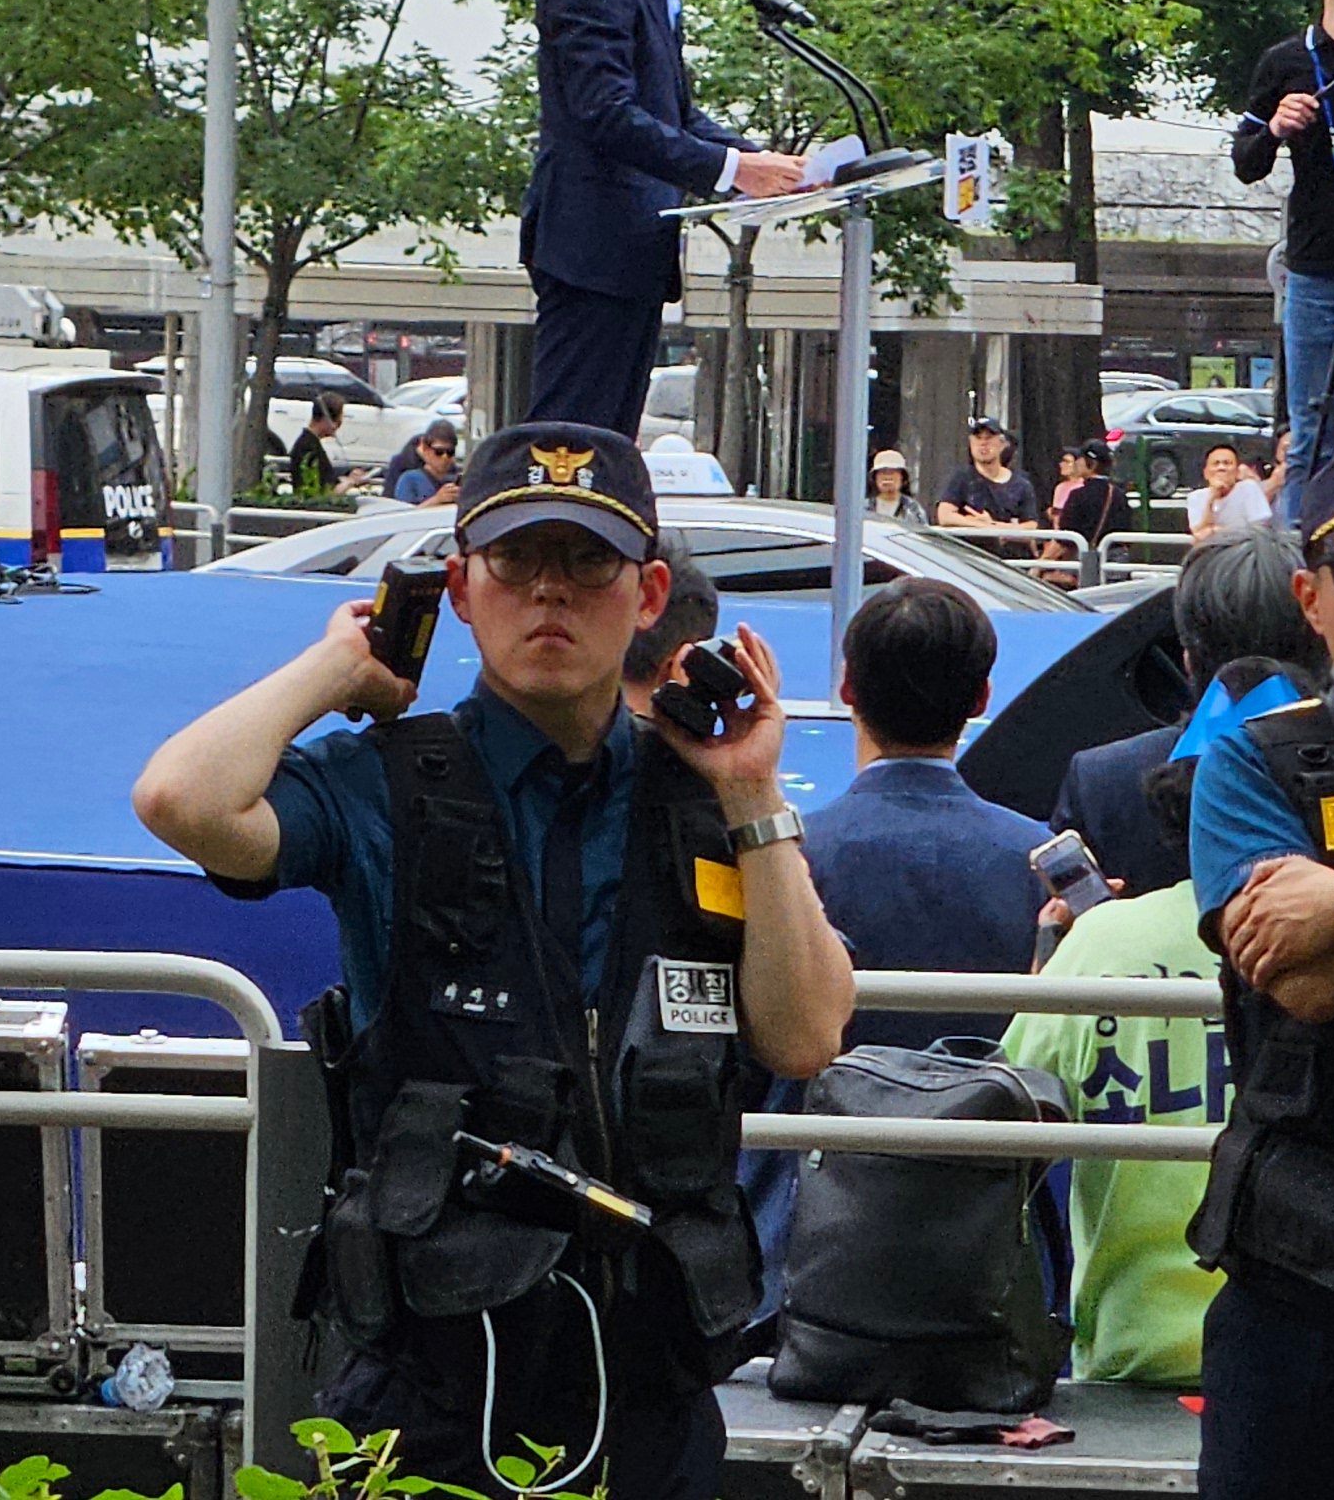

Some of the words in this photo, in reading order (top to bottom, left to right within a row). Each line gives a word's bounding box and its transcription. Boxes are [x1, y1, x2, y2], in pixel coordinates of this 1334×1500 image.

[102, 484, 156, 518] POLICE
[668, 968, 726, 1003] 경찰
[671, 1009, 727, 1025] POLICE
